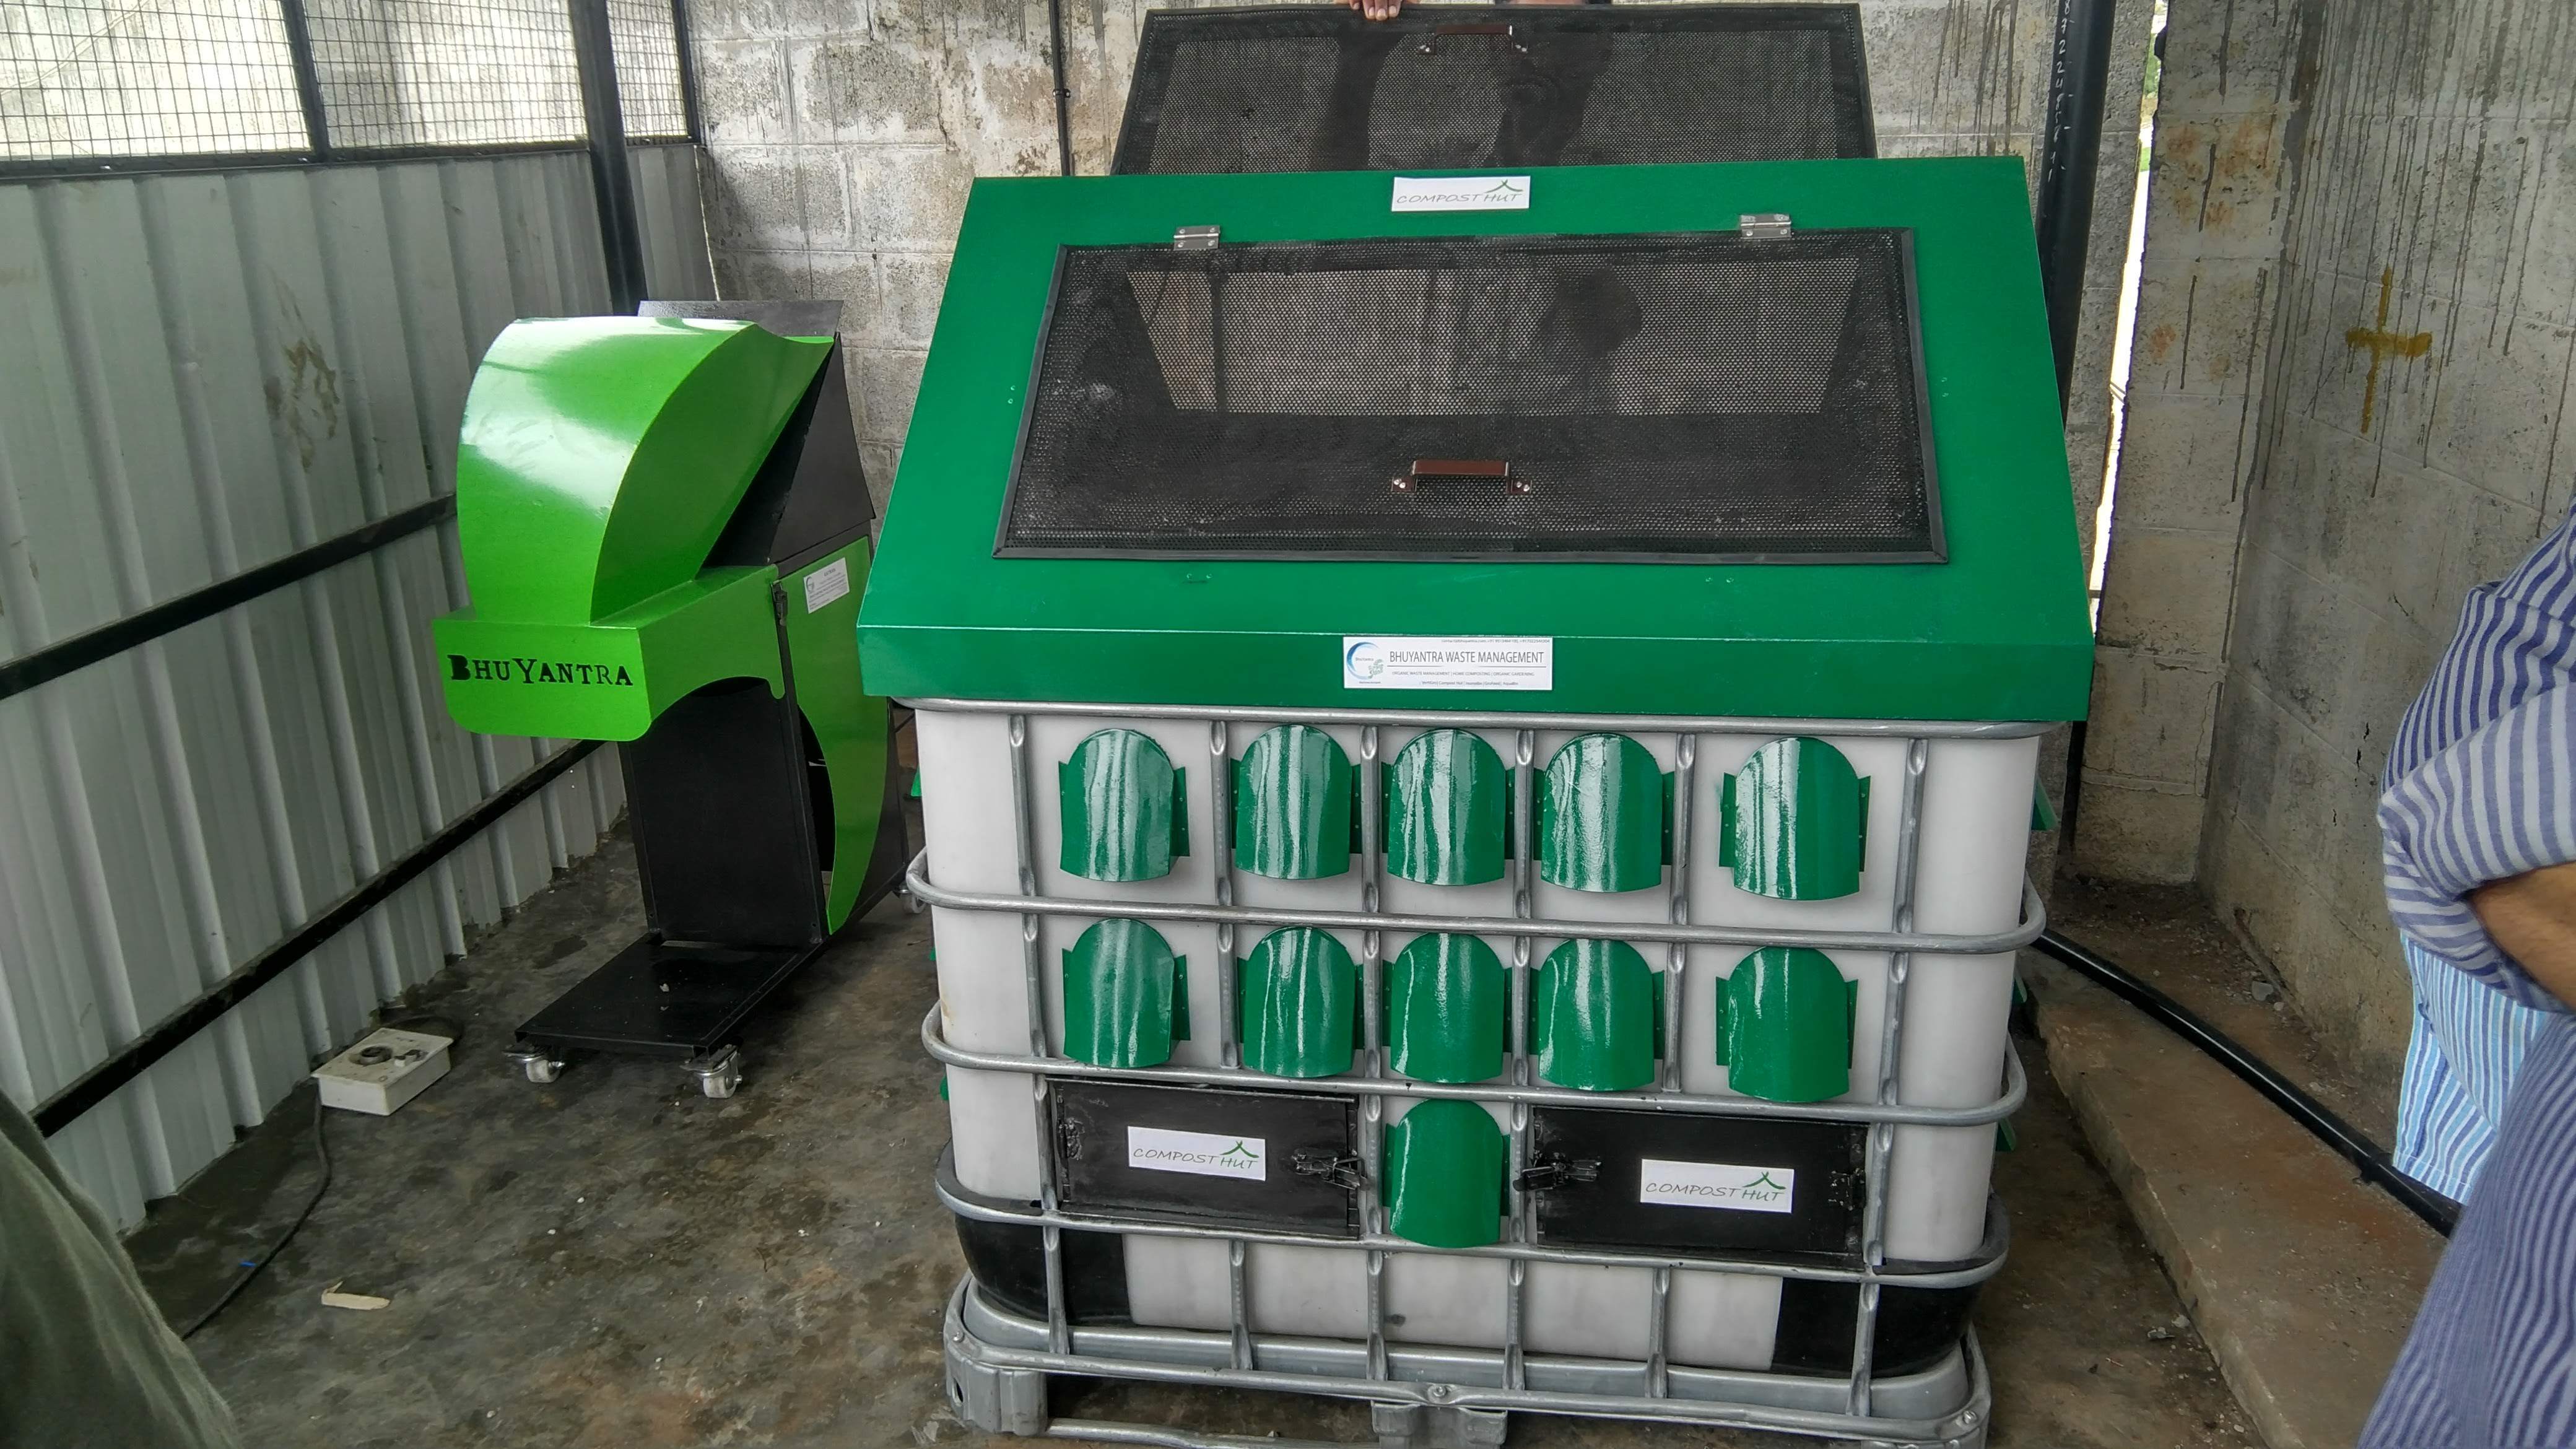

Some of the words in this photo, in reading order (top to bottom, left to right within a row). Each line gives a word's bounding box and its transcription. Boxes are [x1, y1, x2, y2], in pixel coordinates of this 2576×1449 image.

[1396, 194, 1482, 204] COMPOST
[1484, 193, 1522, 202] HUT
[1390, 651, 1443, 663] BHUYANTRA
[1445, 651, 1476, 663] WASTE
[1477, 651, 1544, 663] MANAGEMENT
[1133, 1148, 1220, 1164] COMPOST
[1220, 1157, 1258, 1169] HUT
[1645, 1183, 1741, 1197] COMPOST
[1741, 1189, 1785, 1201] HUT
